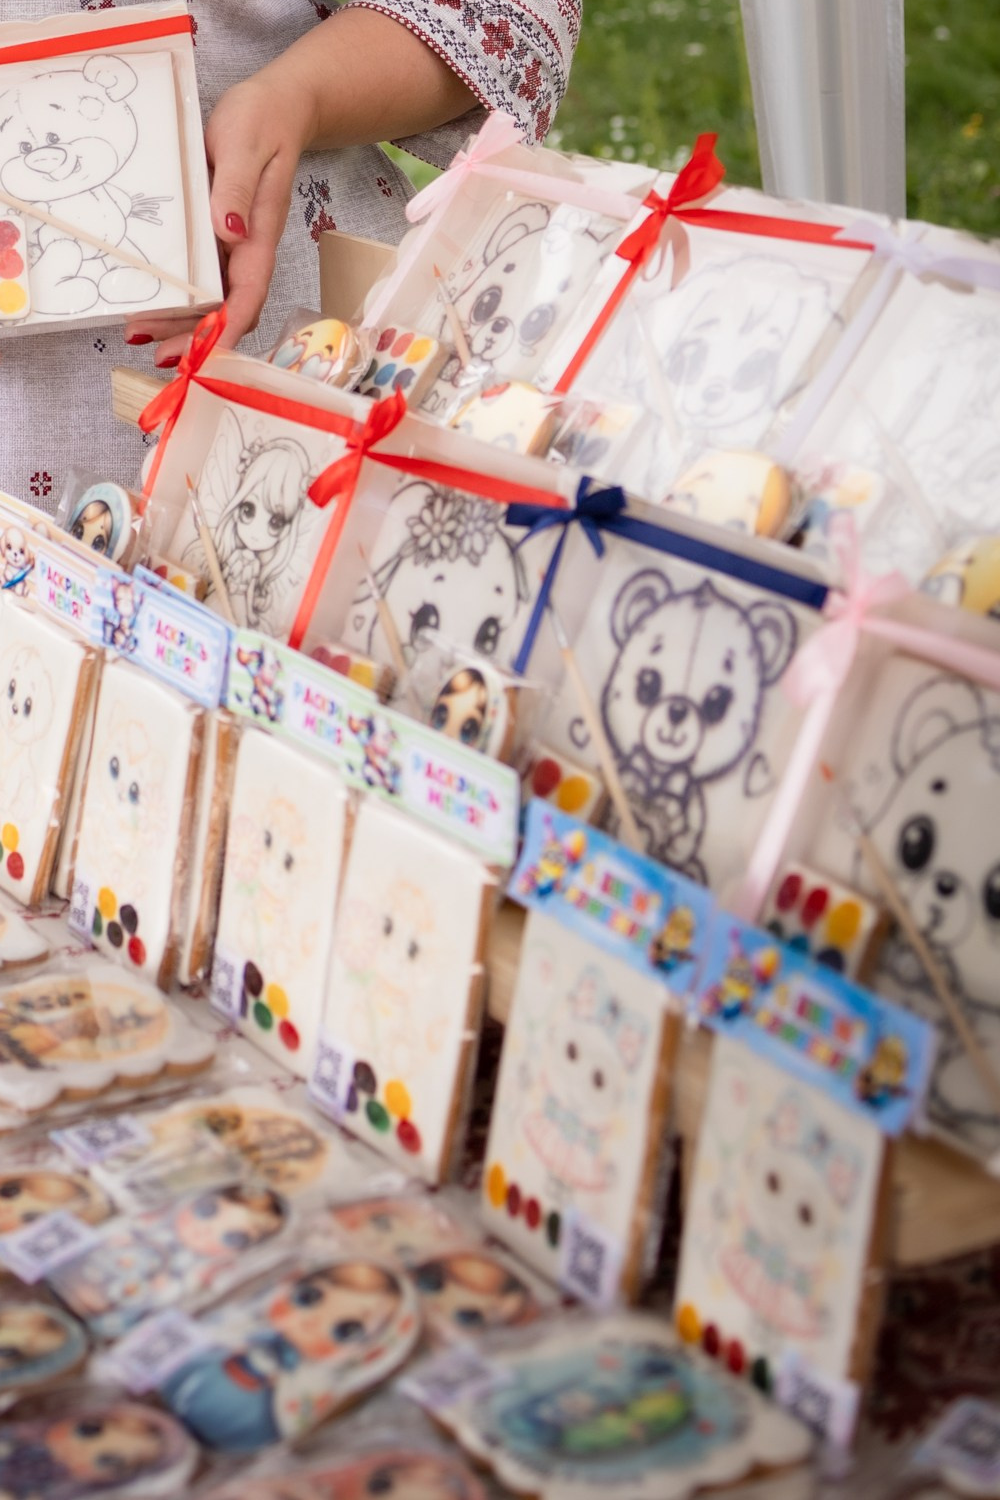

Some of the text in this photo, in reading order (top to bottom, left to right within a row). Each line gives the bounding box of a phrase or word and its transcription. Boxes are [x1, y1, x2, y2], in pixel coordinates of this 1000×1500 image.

[40, 561, 92, 606] РАСКРАСЬ
[47, 588, 84, 620] МЕНЯ!
[293, 680, 344, 723] РАСКРА
